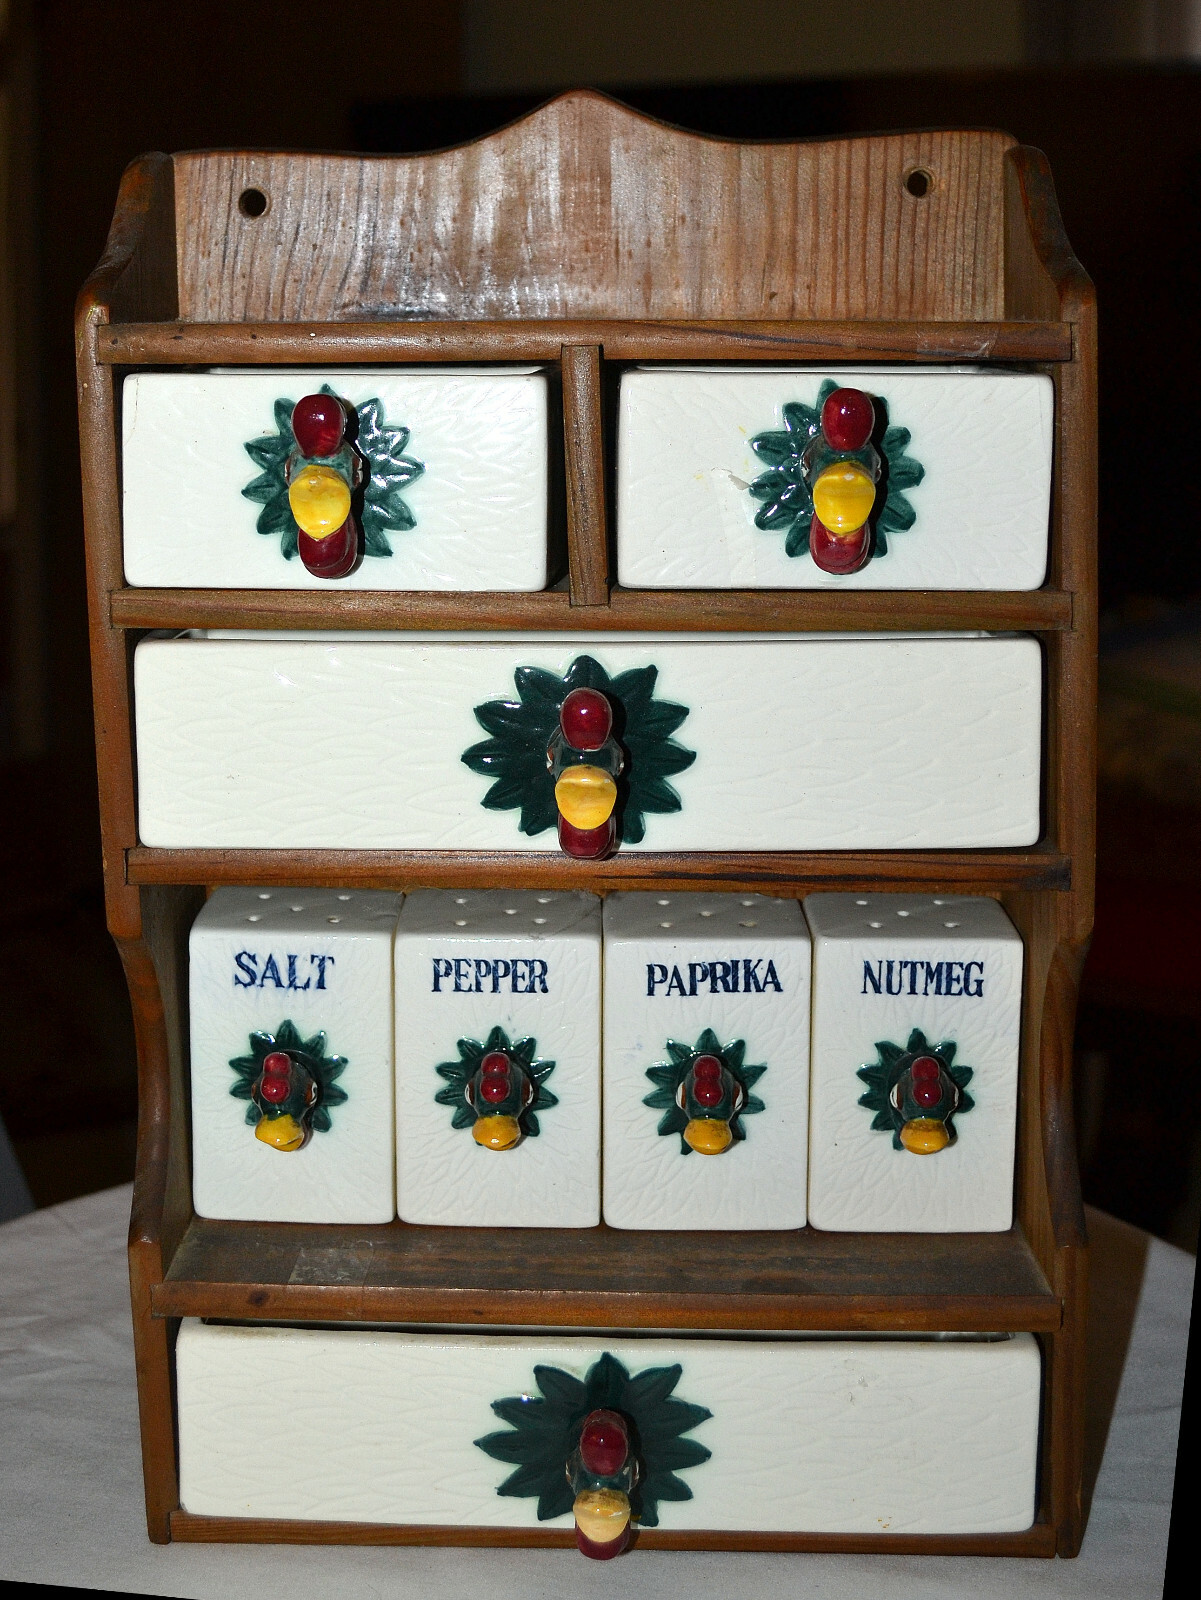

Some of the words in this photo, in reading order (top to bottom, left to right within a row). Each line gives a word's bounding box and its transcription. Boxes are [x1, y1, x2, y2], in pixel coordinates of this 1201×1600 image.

[233, 951, 335, 990] SALT
[431, 958, 550, 994] PEPPER
[646, 959, 784, 997] PAPRIKA
[861, 960, 985, 997] NUTMEG
